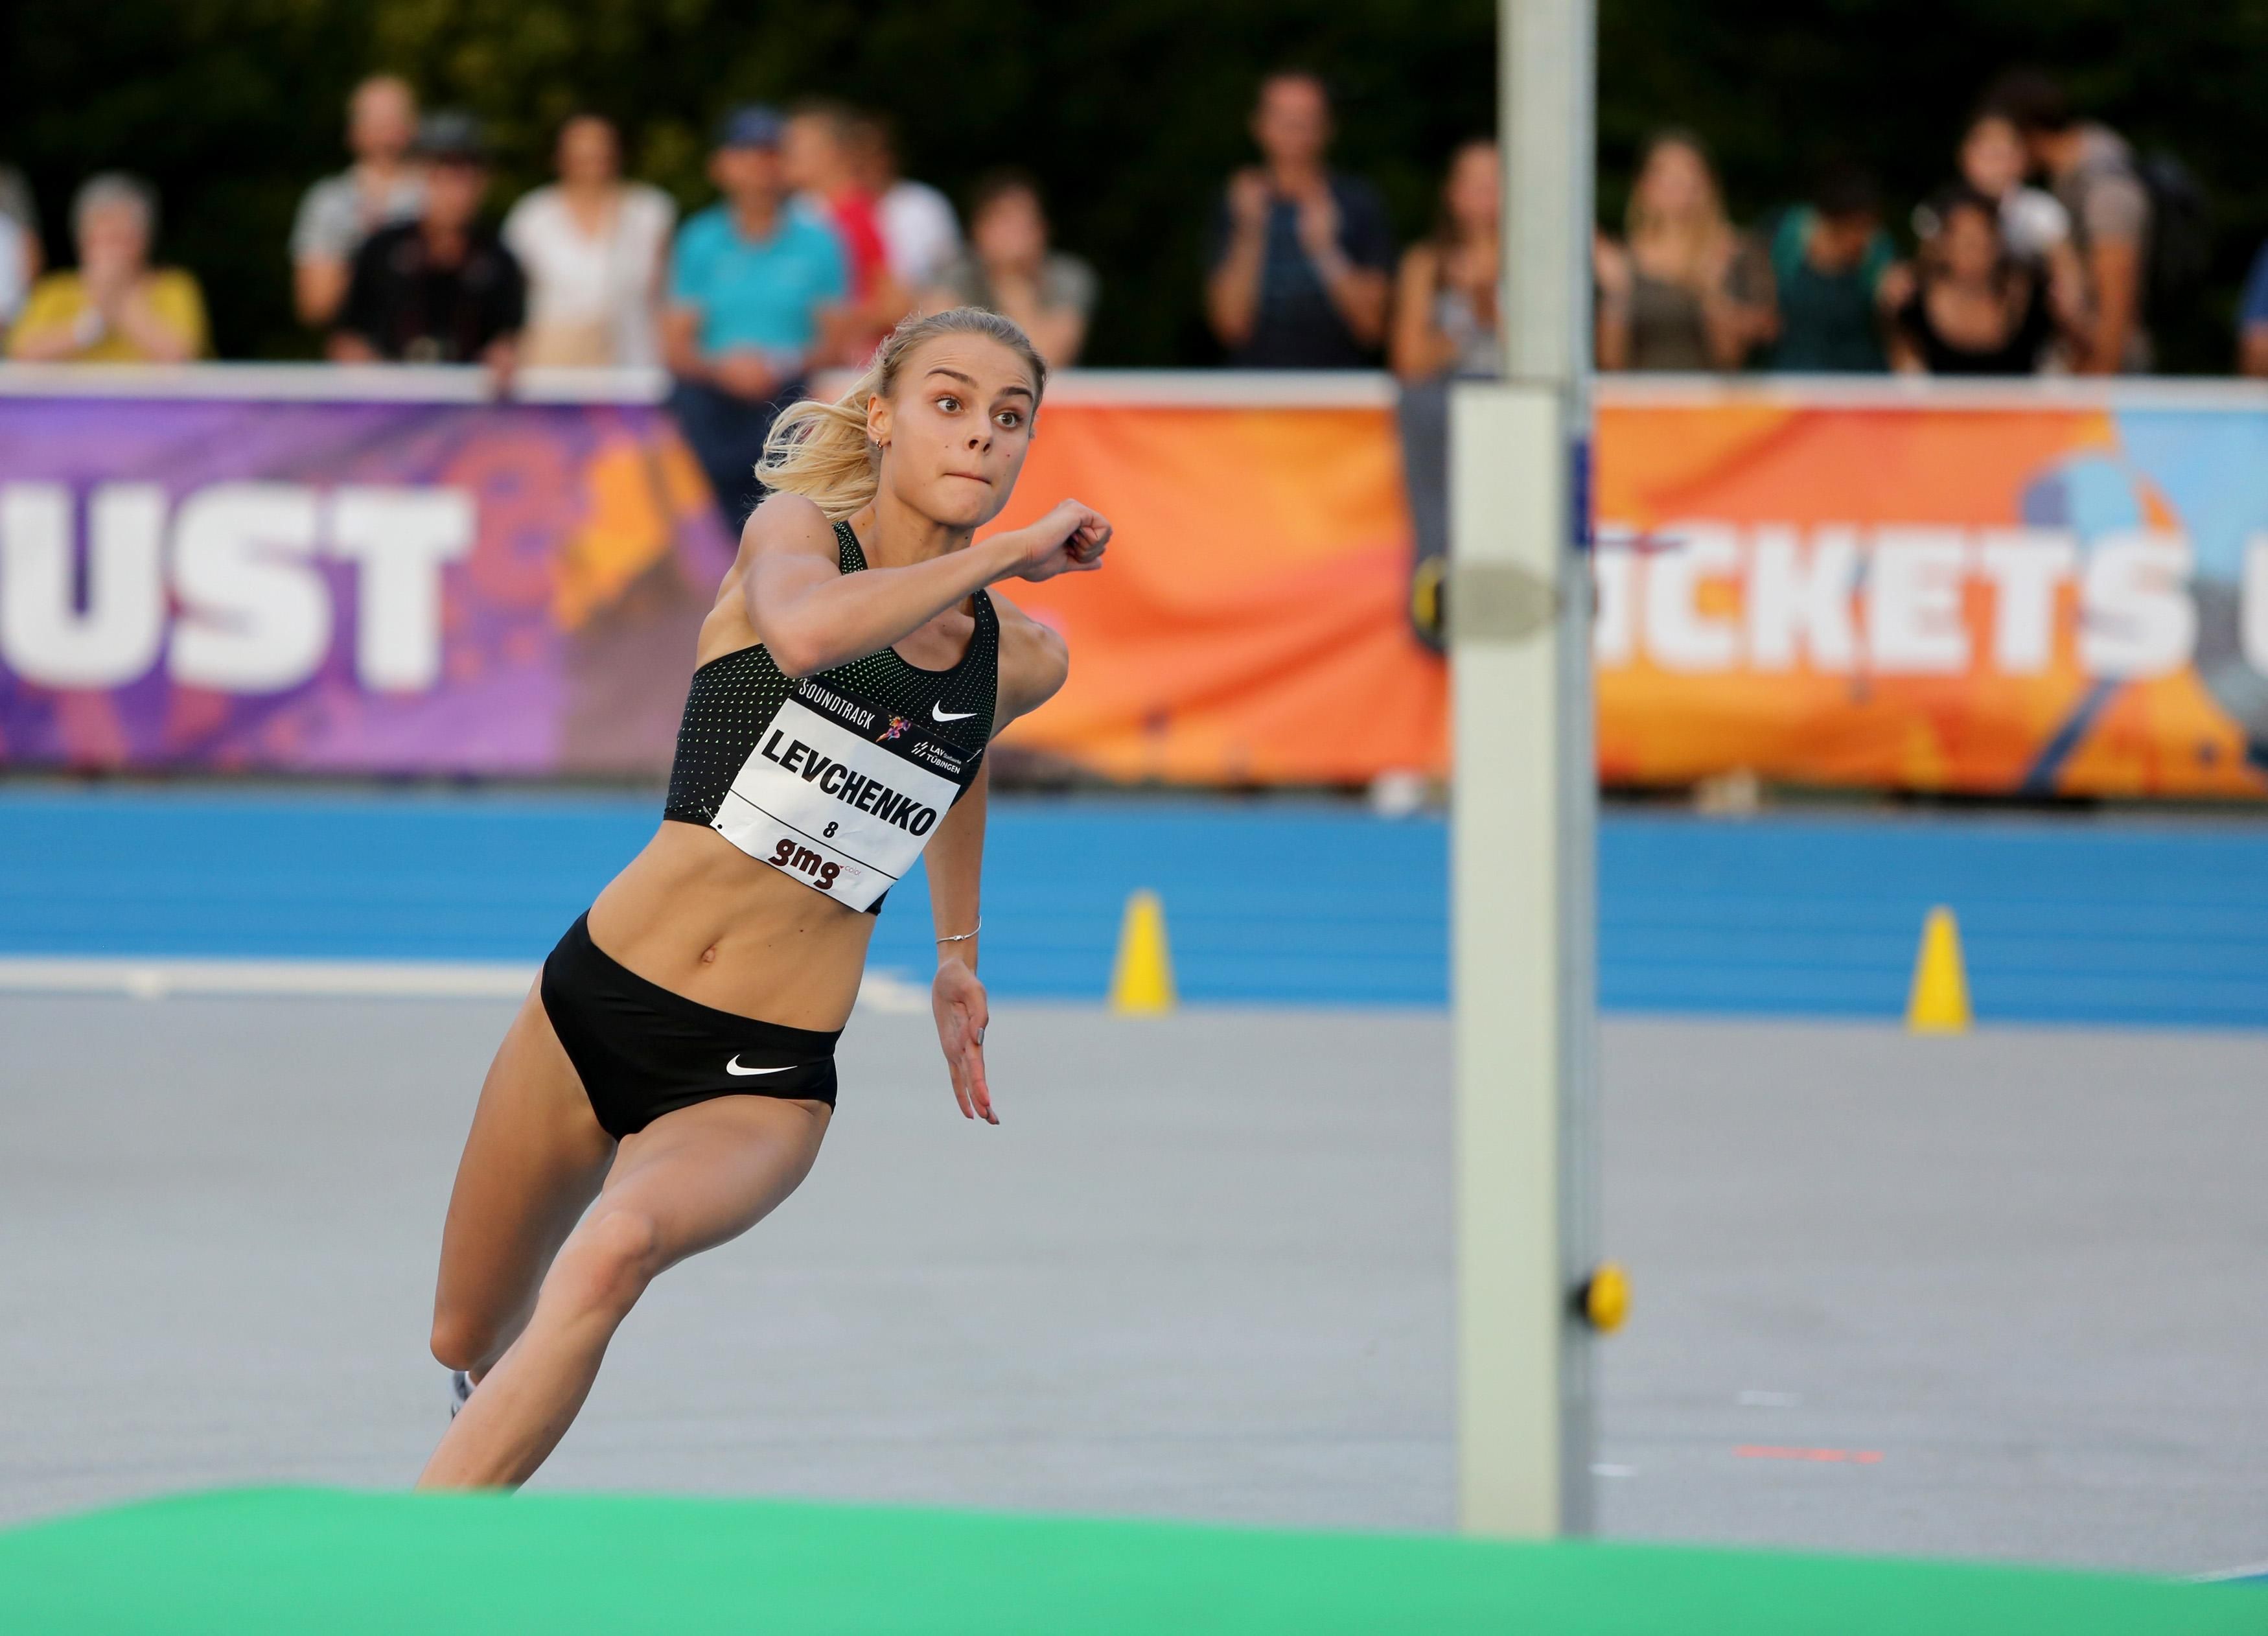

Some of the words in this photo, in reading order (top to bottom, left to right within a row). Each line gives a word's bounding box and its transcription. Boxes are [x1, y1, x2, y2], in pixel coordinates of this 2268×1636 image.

[1, 481, 478, 692] UST
[1593, 525, 2198, 678] ICKETS
[798, 678, 875, 730] SOUNDTRACK
[927, 753, 960, 774] TÜBINGEN
[930, 745, 945, 756] LAV
[761, 730, 937, 836] LEVCHENKO
[823, 821, 839, 838] 8
[767, 839, 840, 890] gmg
